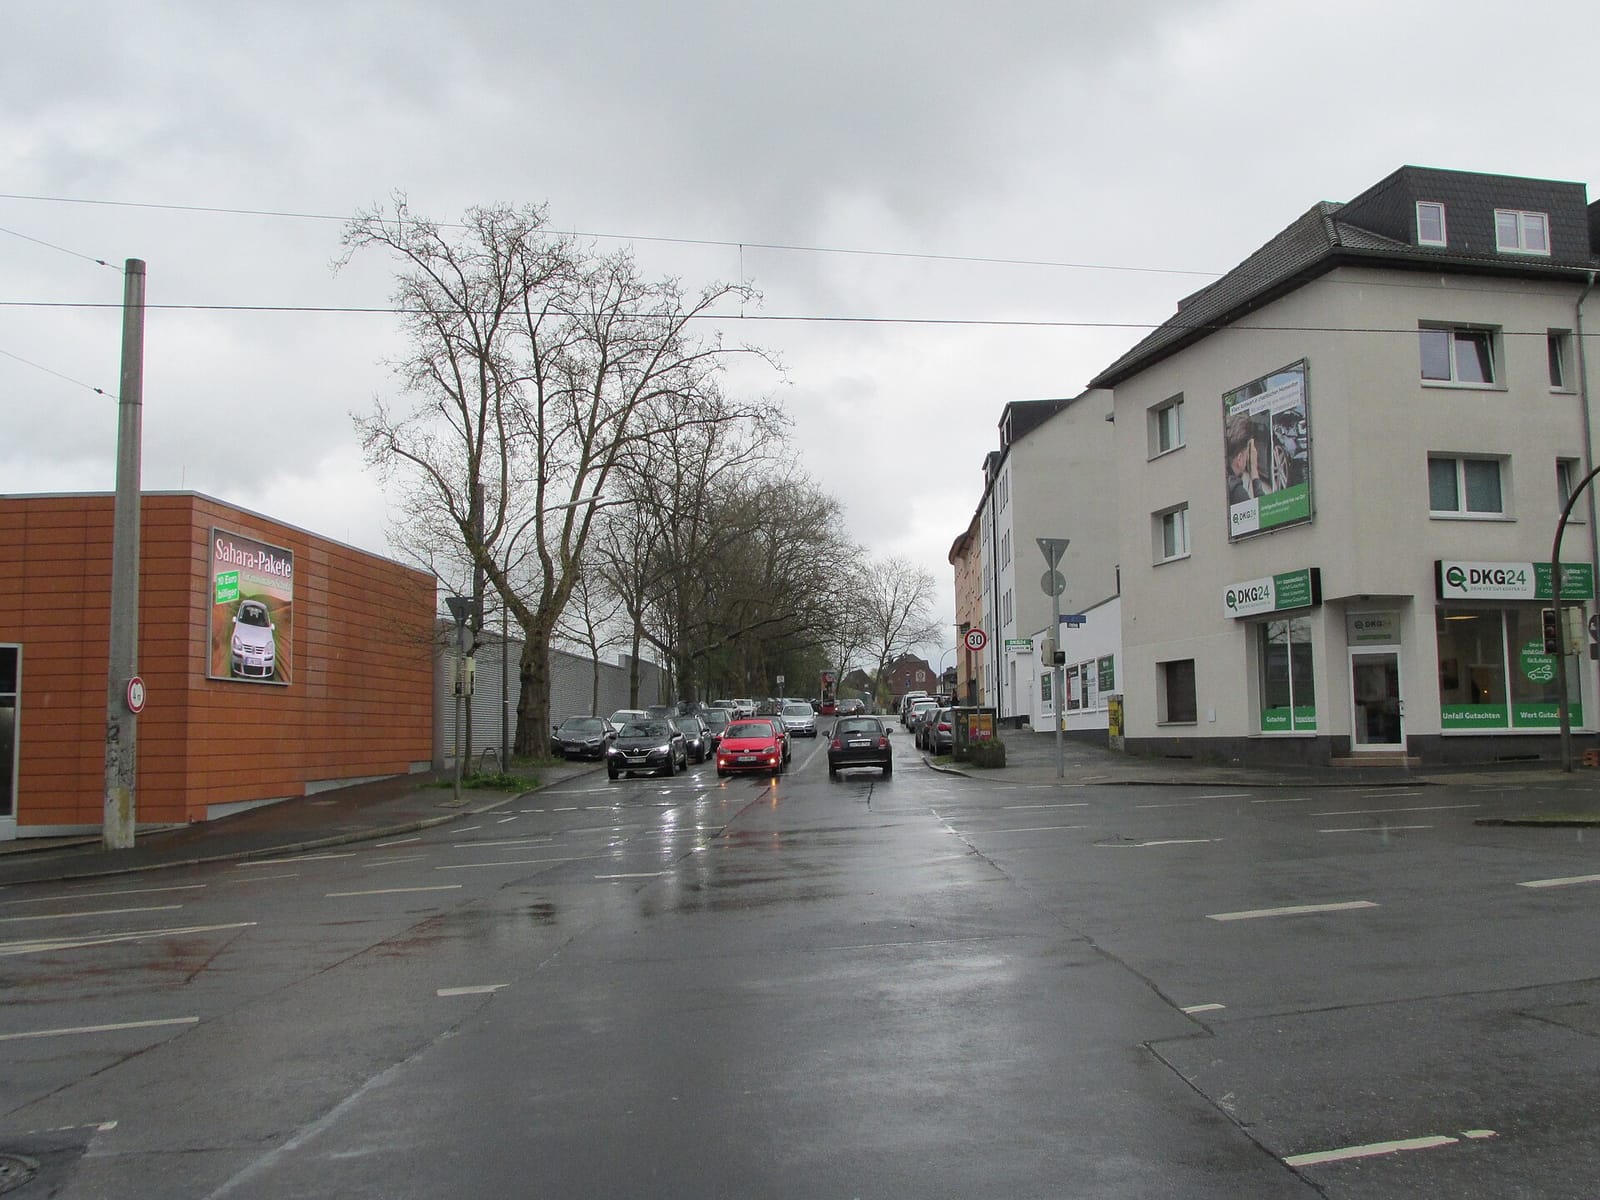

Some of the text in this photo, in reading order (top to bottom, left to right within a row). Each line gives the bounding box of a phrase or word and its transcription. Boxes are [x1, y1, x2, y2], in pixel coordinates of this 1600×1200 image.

[215, 538, 292, 579] Sahara-Pakete
[225, 575, 238, 585] Euro
[1469, 569, 1527, 585] DKG24
[1237, 585, 1270, 604] DKG24
[969, 634, 983, 646] 30
[1442, 711, 1501, 720] Unfall Gutachten
[1520, 711, 1537, 719] Wert
